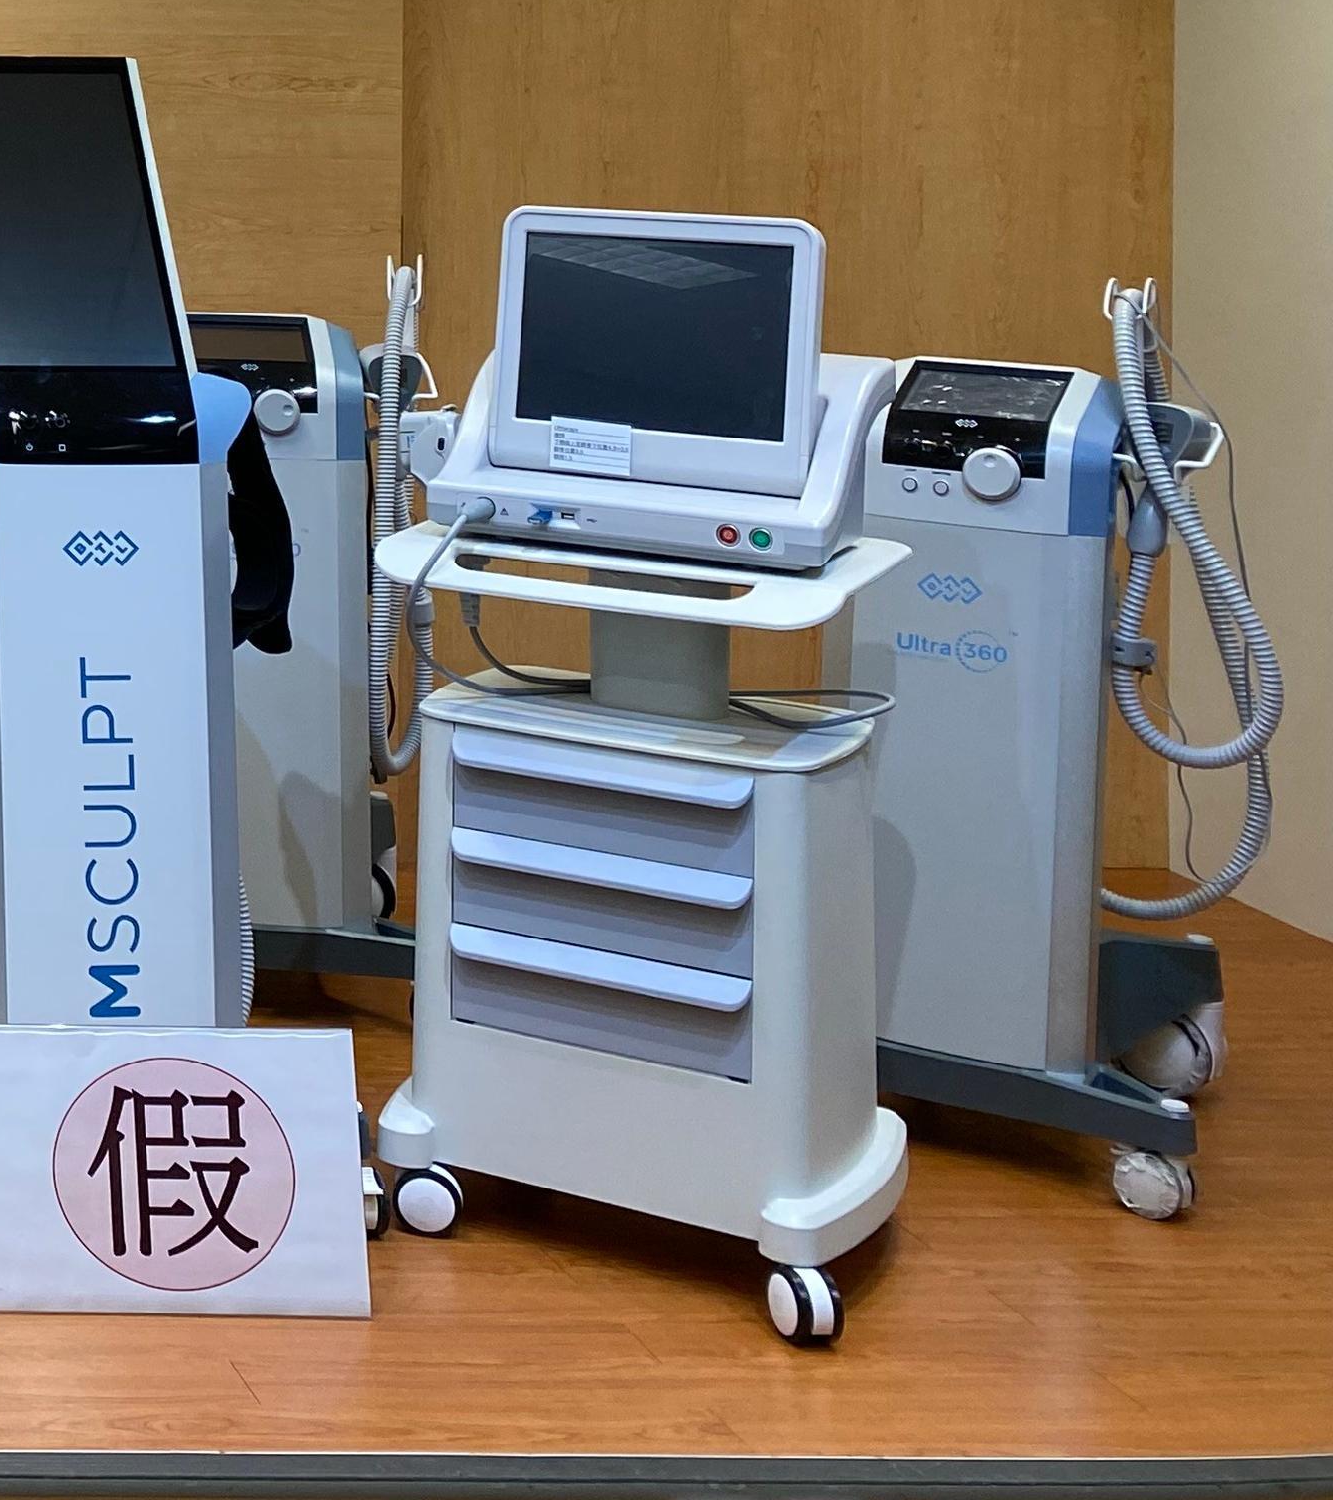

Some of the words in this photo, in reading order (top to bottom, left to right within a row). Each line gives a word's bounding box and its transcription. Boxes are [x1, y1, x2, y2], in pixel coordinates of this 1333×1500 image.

[896, 631, 952, 656] Ultra
[963, 641, 1008, 663] 360
[79, 656, 142, 1018] MSCULPT
[87, 1085, 259, 1257] 假
